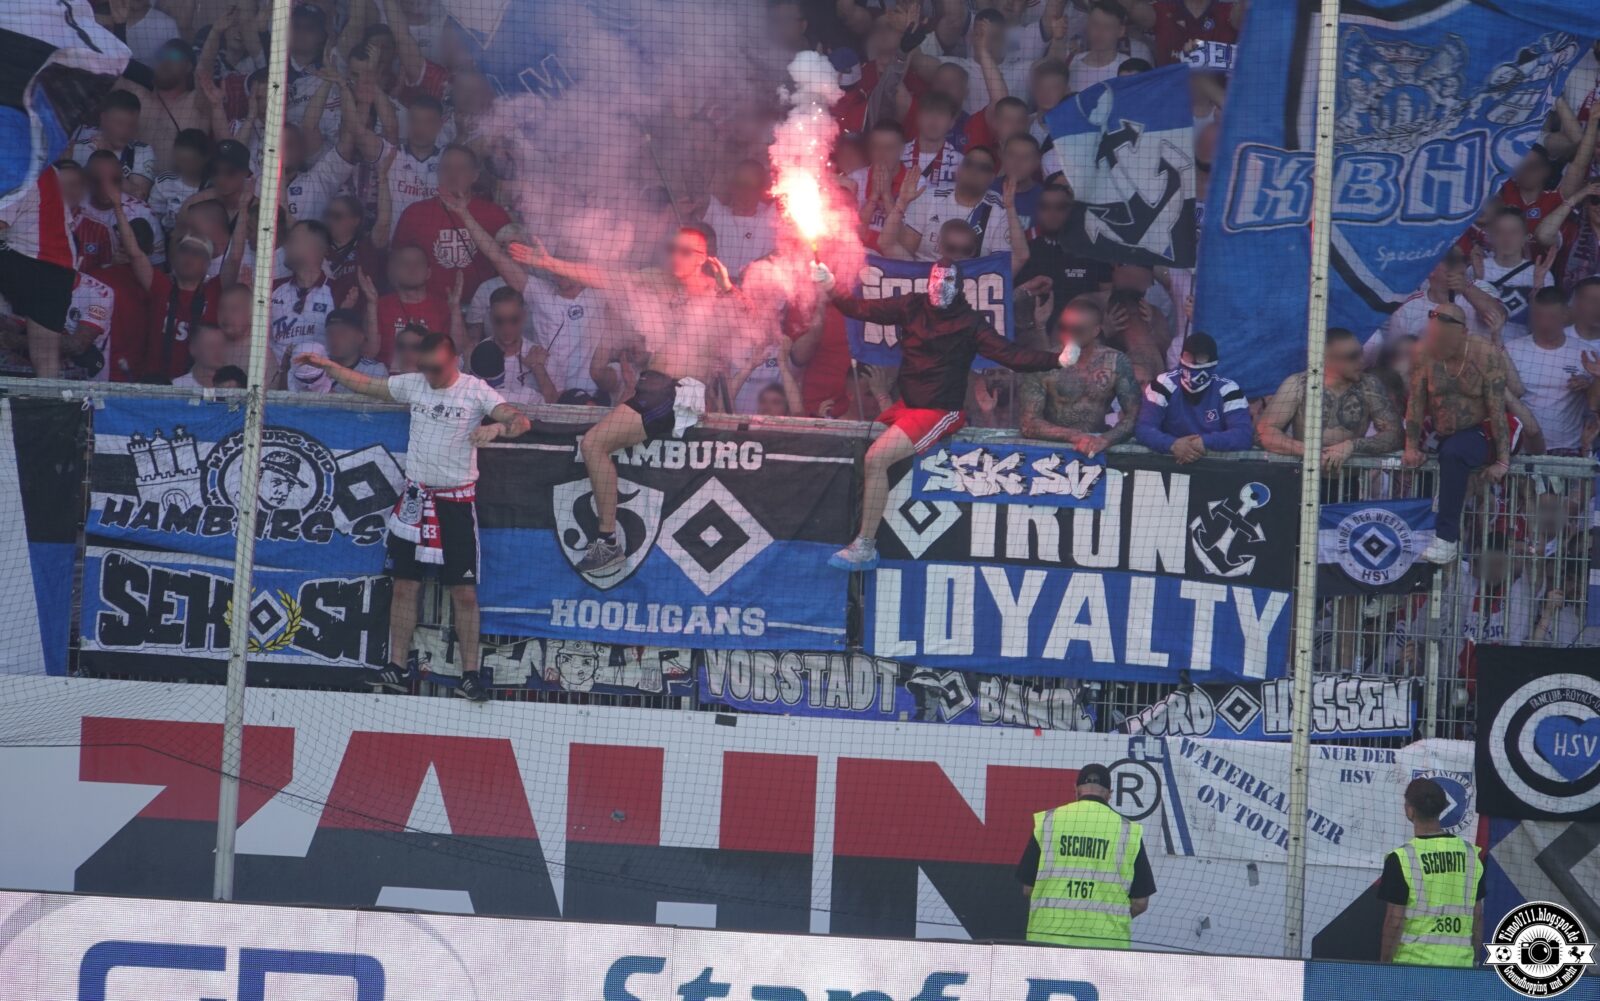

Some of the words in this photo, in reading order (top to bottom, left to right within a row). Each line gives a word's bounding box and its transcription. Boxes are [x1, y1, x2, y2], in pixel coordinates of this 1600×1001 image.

[398, 181, 437, 196] Emirate
[1361, 569, 1389, 582] HSV
[550, 598, 766, 637] HOOLIGANS
[873, 564, 1290, 680] LOYALTY
[705, 649, 899, 713] VORSTADT
[1262, 676, 1411, 736] HSSEN
[1319, 746, 1357, 763] NUR
[1362, 748, 1397, 765] DER
[1553, 732, 1599, 758] HSV
[1340, 768, 1375, 785] HSV
[1178, 737, 1346, 845] WATERKATER
[1197, 784, 1233, 815] ON
[1060, 835, 1110, 860] SECURITY
[1420, 850, 1466, 875] SECURITY
[1066, 880, 1095, 899] 1767
[1430, 917, 1462, 934] 680
